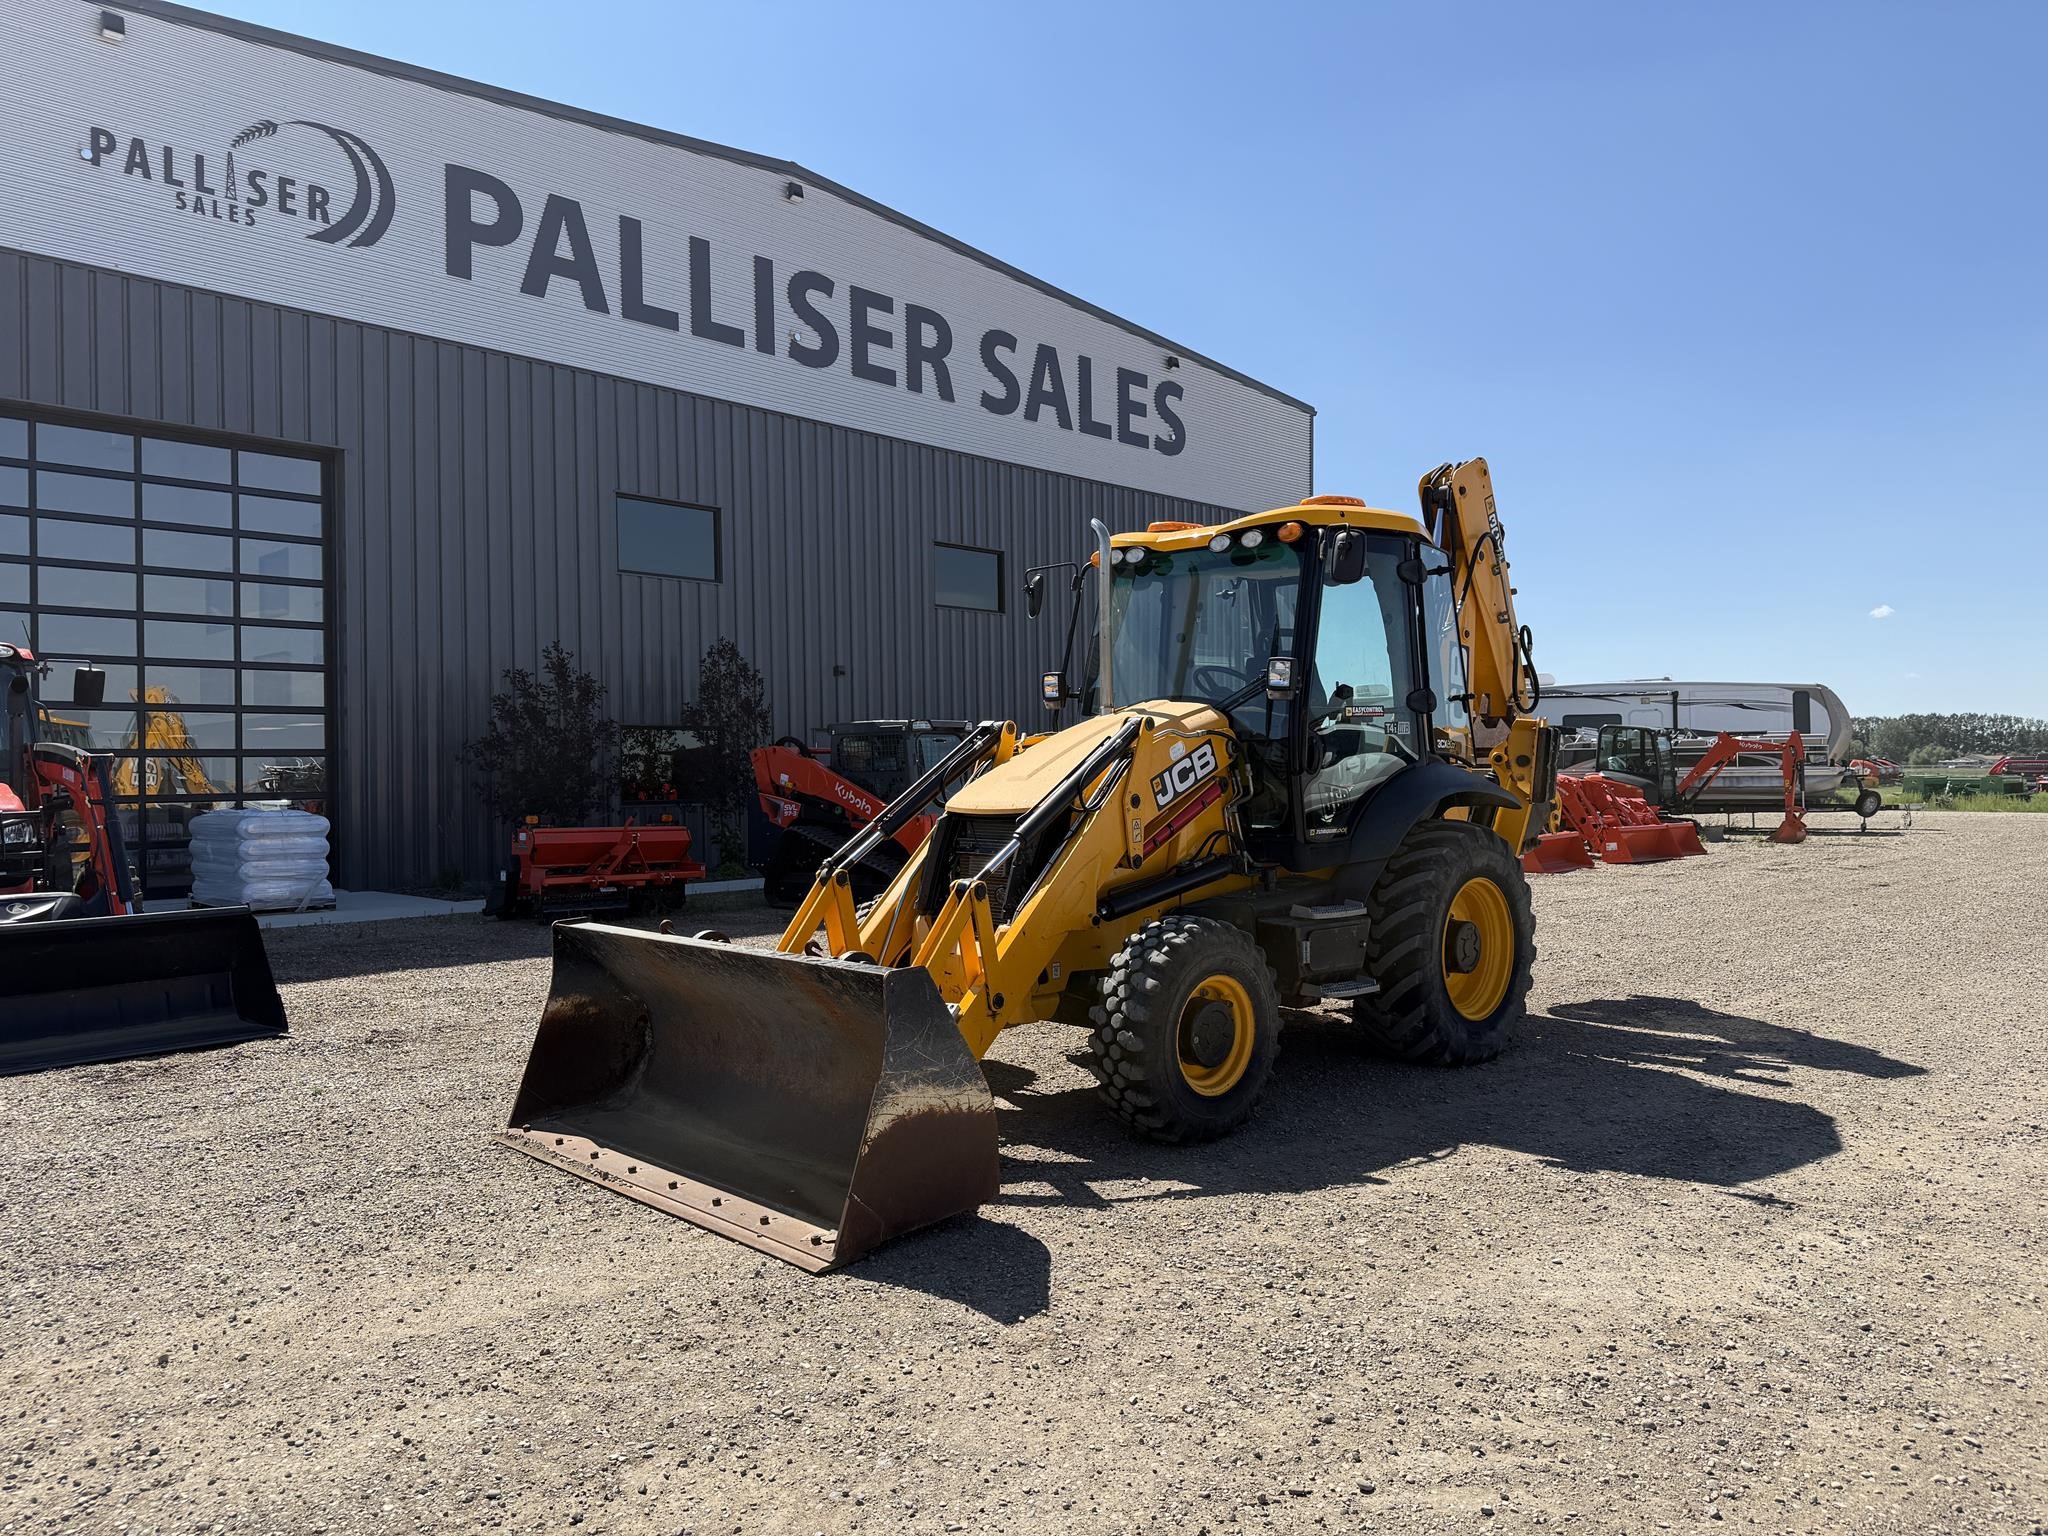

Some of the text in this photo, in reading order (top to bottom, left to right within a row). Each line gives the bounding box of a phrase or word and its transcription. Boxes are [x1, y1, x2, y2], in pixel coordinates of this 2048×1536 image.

[90, 126, 331, 226] PALLISER
[175, 191, 256, 227] SALES
[445, 163, 1187, 457] PALLISER SALES
[1353, 706, 1384, 715] EASYCONTROL
[834, 782, 872, 815] Kubota
[1156, 743, 1216, 806] JCB
